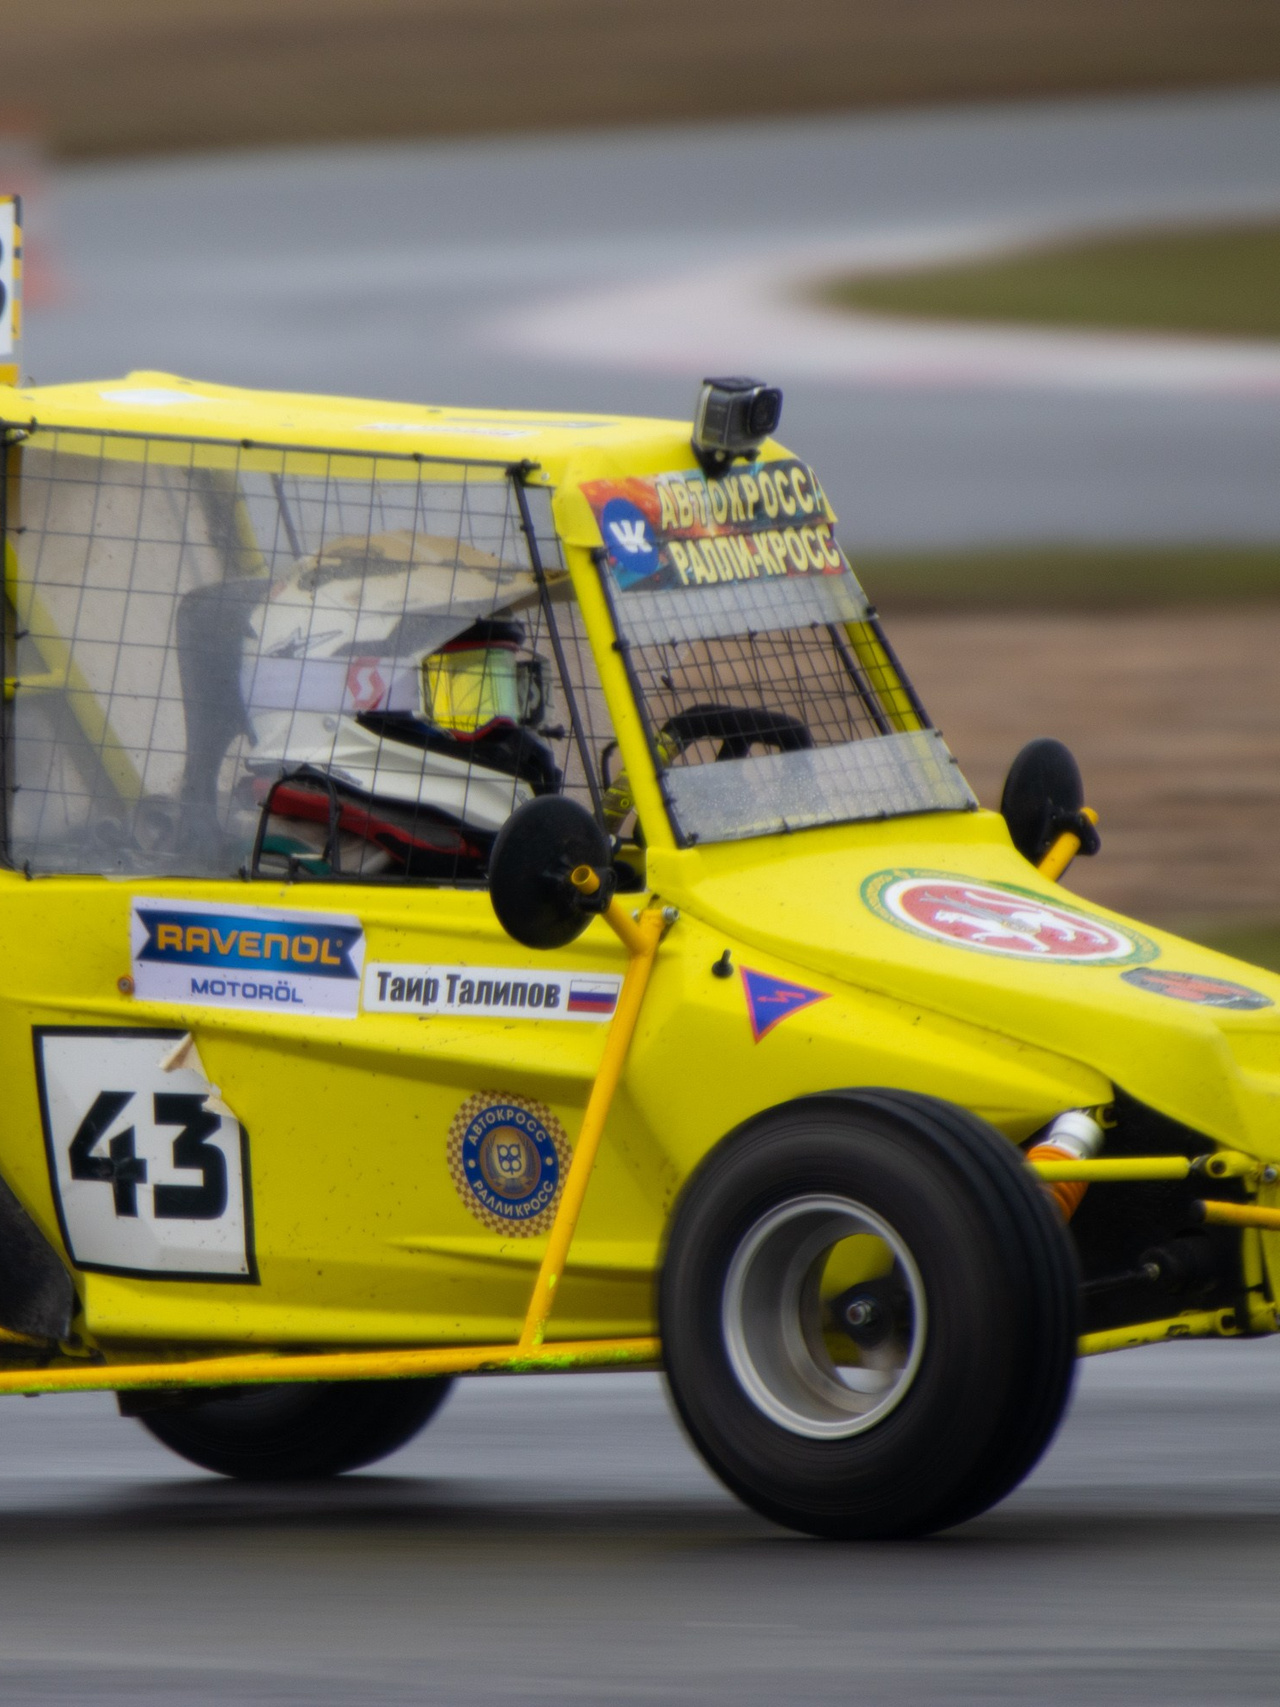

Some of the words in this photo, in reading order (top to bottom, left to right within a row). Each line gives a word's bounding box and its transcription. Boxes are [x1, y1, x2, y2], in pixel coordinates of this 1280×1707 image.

[668, 523, 841, 586] РАЛЛИ-КРОСС
[156, 923, 342, 965] RAVENOL
[190, 977, 304, 1004] MOTORÖL
[377, 971, 438, 1004] Таир
[446, 973, 561, 1009] Талипов
[467, 1109, 547, 1146] АВТОКРОСС
[70, 1091, 227, 1218] 43
